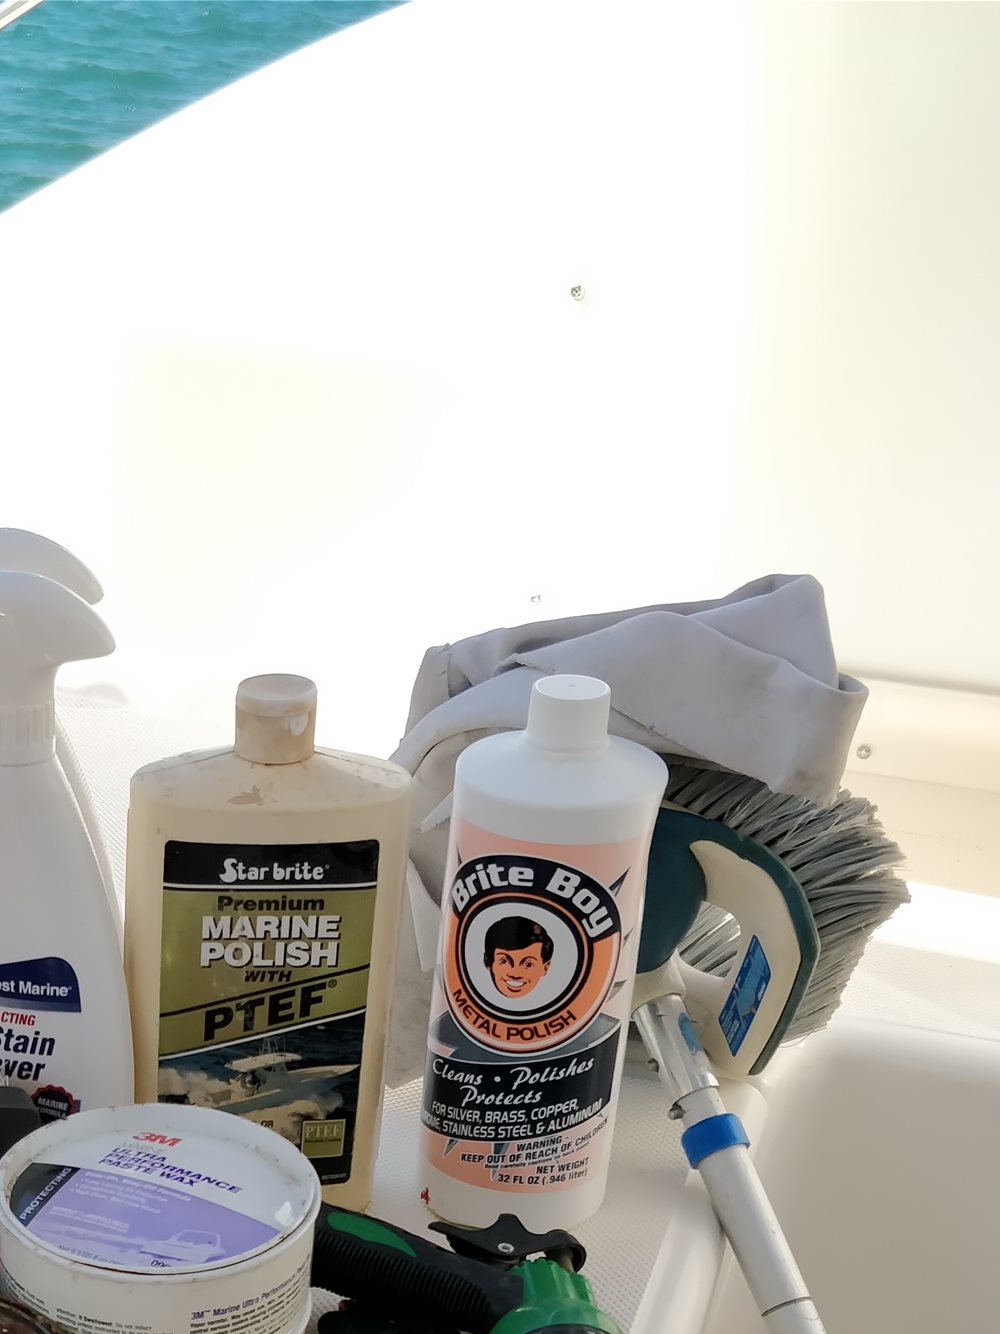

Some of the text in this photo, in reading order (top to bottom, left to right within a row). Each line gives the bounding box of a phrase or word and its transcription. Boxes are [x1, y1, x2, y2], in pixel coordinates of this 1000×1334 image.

[218, 857, 325, 884] Star brite
[217, 895, 325, 911] Premium
[451, 861, 615, 939] Brite Boy
[201, 915, 342, 940] MARINE
[200, 941, 340, 968] POLISH
[19, 980, 70, 997] Marine
[244, 970, 292, 983] WITH
[203, 982, 328, 1042] PTEF
[452, 988, 578, 1042] METAL POLISH
[432, 1057, 595, 1090] Cleans Polishes
[459, 1085, 544, 1107] Protects
[432, 1098, 579, 1124] FOR SILVER, BRASS, COPPER,
[442, 1120, 496, 1138] STAINLESS
[497, 1123, 532, 1139] STEEL
[536, 1123, 545, 1134] &
[547, 1098, 603, 1133] ALUMINUM
[132, 1132, 183, 1148] 3M
[304, 1125, 341, 1138] PTEF
[460, 1117, 608, 1164] KEEP OUT OF REACH OF CHILDREN
[516, 1135, 563, 1152] WARNING
[112, 1147, 167, 1162] ULTRA
[536, 1156, 590, 1175] NET WEIGHT
[98, 1158, 200, 1188] PASTE WAX
[104, 1153, 243, 1194] PERFORMANCE
[497, 1173, 510, 1183] 32
[513, 1175, 524, 1185] FL
[527, 1176, 540, 1185] OZ
[19, 1167, 73, 1221] PROTECTING
[213, 1304, 240, 1317] Marine
